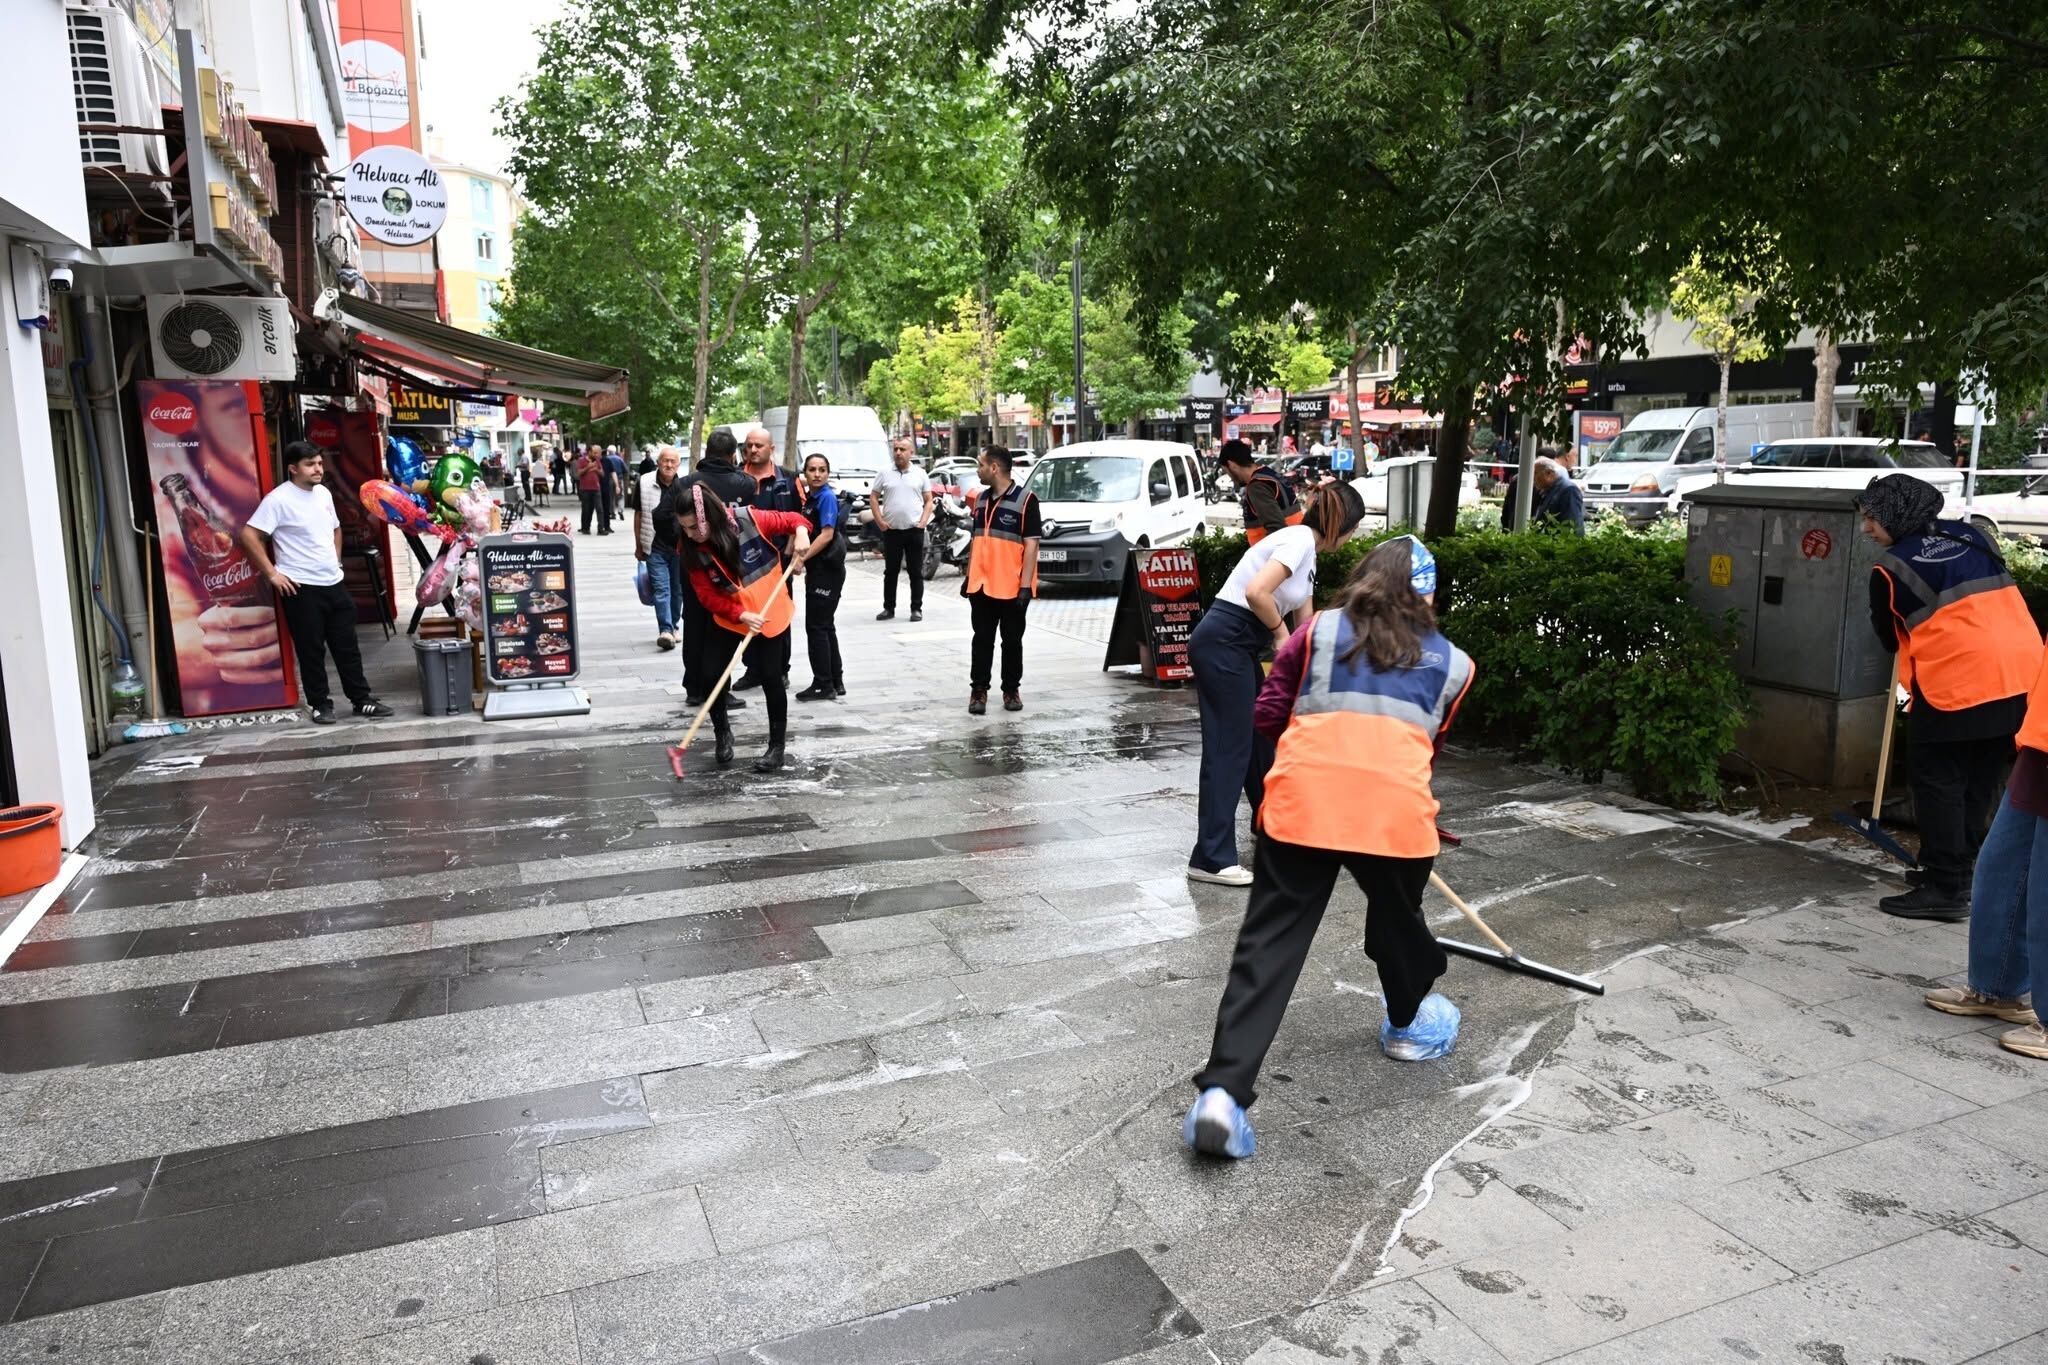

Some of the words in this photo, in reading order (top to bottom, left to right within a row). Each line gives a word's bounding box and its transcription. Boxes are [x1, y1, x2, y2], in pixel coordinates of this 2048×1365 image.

[358, 83, 408, 98] Boğaziçi
[352, 162, 411, 184] Helvacı
[350, 194, 378, 203] HELVA
[415, 200, 446, 209] LOKUM
[384, 228, 415, 239] Helvası
[258, 305, 276, 355] arçelik
[1608, 382, 1626, 391] urba
[1191, 402, 1214, 410] Volkan
[1292, 401, 1323, 412] PARDOLE
[396, 411, 420, 421] MUSA
[1195, 411, 1211, 420] Spor
[1337, 450, 1349, 468] P
[527, 550, 544, 562] Ali
[1051, 551, 1065, 560] 105
[1139, 552, 1194, 573] FATİH
[1147, 574, 1194, 588] İLETİŞİM
[1155, 624, 1188, 633] TABLET
